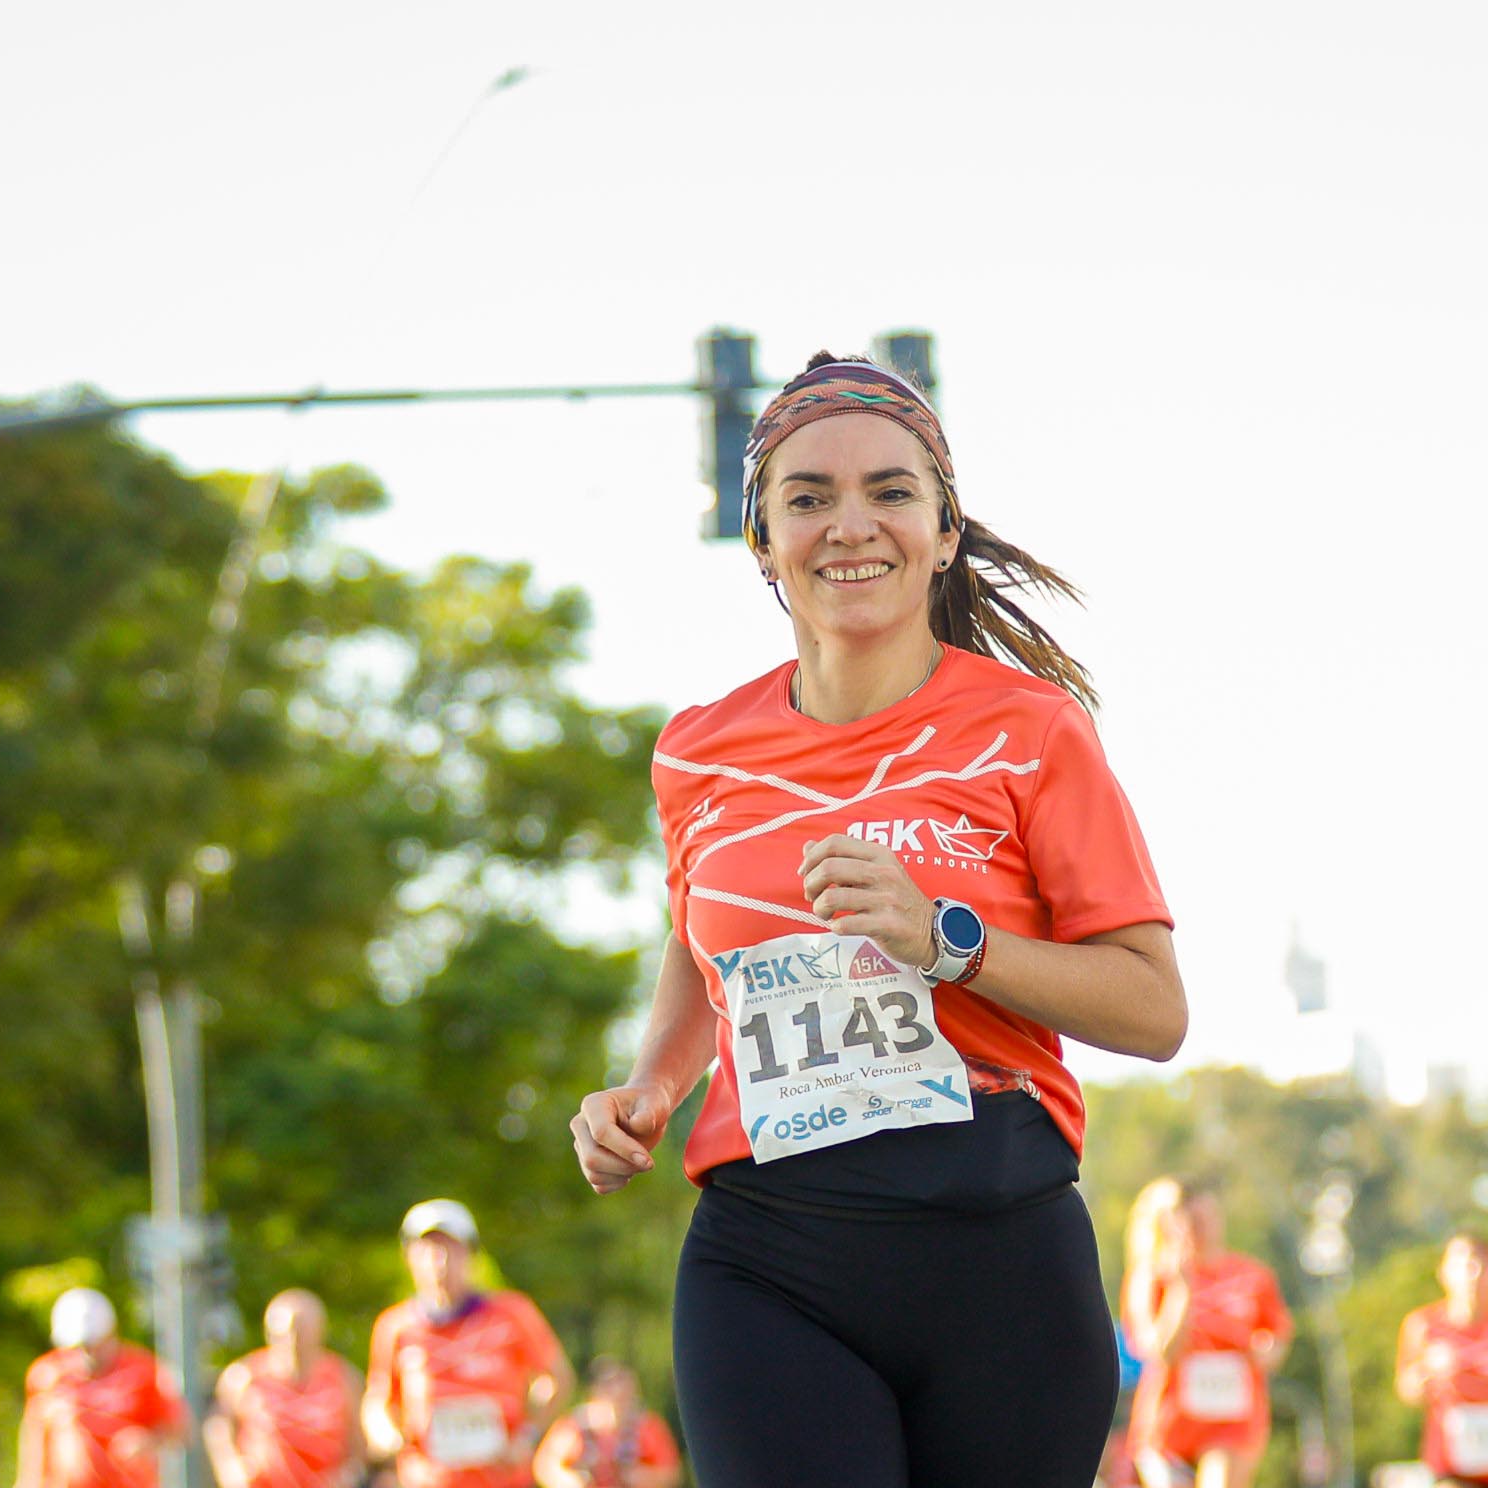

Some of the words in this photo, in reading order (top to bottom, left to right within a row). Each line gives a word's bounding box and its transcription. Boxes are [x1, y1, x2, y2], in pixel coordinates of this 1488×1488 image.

[934, 856, 988, 874] NORTE
[740, 955, 801, 994] 15K
[853, 957, 886, 975] 15K
[744, 993, 773, 1006] PUERTO
[774, 988, 797, 1000] NORTE
[739, 990, 935, 1084] 1143
[778, 1083, 811, 1099] Roca
[814, 1070, 855, 1090] Ambar
[859, 1061, 922, 1079] Veronica
[774, 1103, 848, 1140] osde
